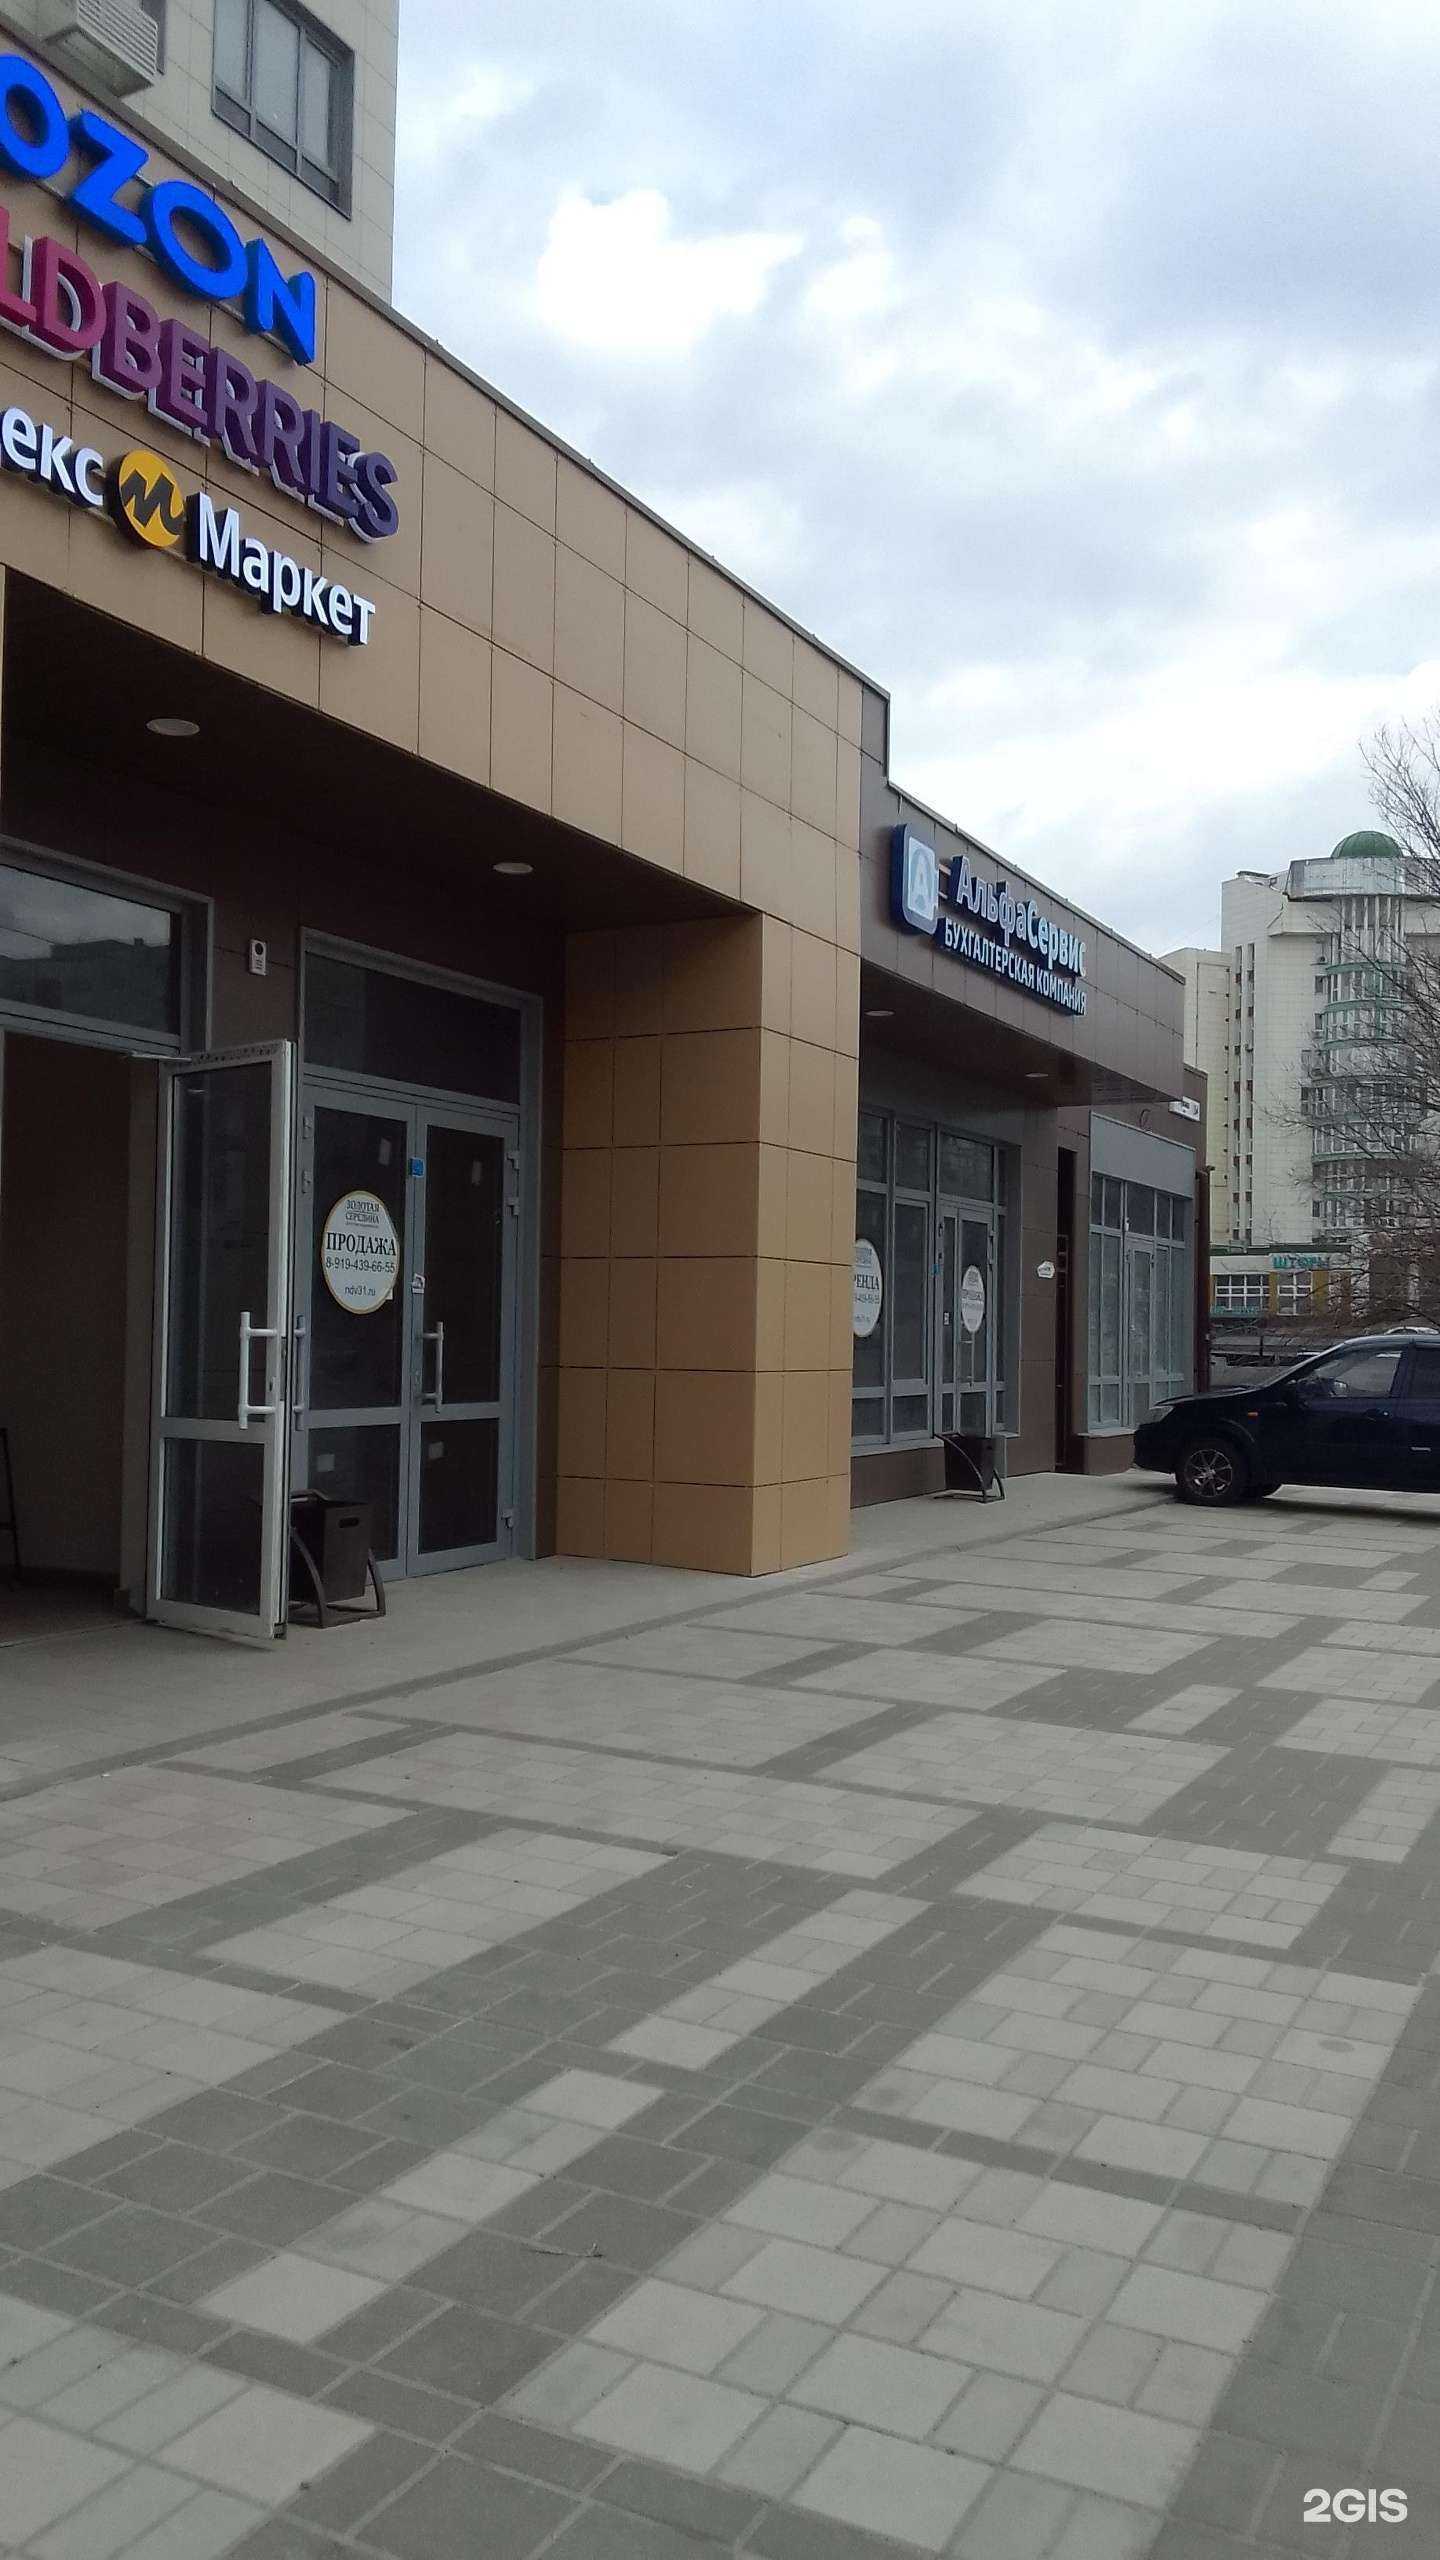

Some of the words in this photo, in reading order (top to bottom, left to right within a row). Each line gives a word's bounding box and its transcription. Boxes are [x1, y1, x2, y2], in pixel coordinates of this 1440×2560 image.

[0, 53, 316, 365] OZON
[199, 490, 376, 647] Маркет
[944, 917, 1035, 990] БУХГАЛТЕРСКАЯ
[1036, 965, 1087, 1016] КОМПАНИЯ
[955, 855, 1087, 979] АльфаСервис
[325, 1256, 395, 1274] 8-919-439-66-55
[326, 1232, 396, 1256] ПРОДАЖА
